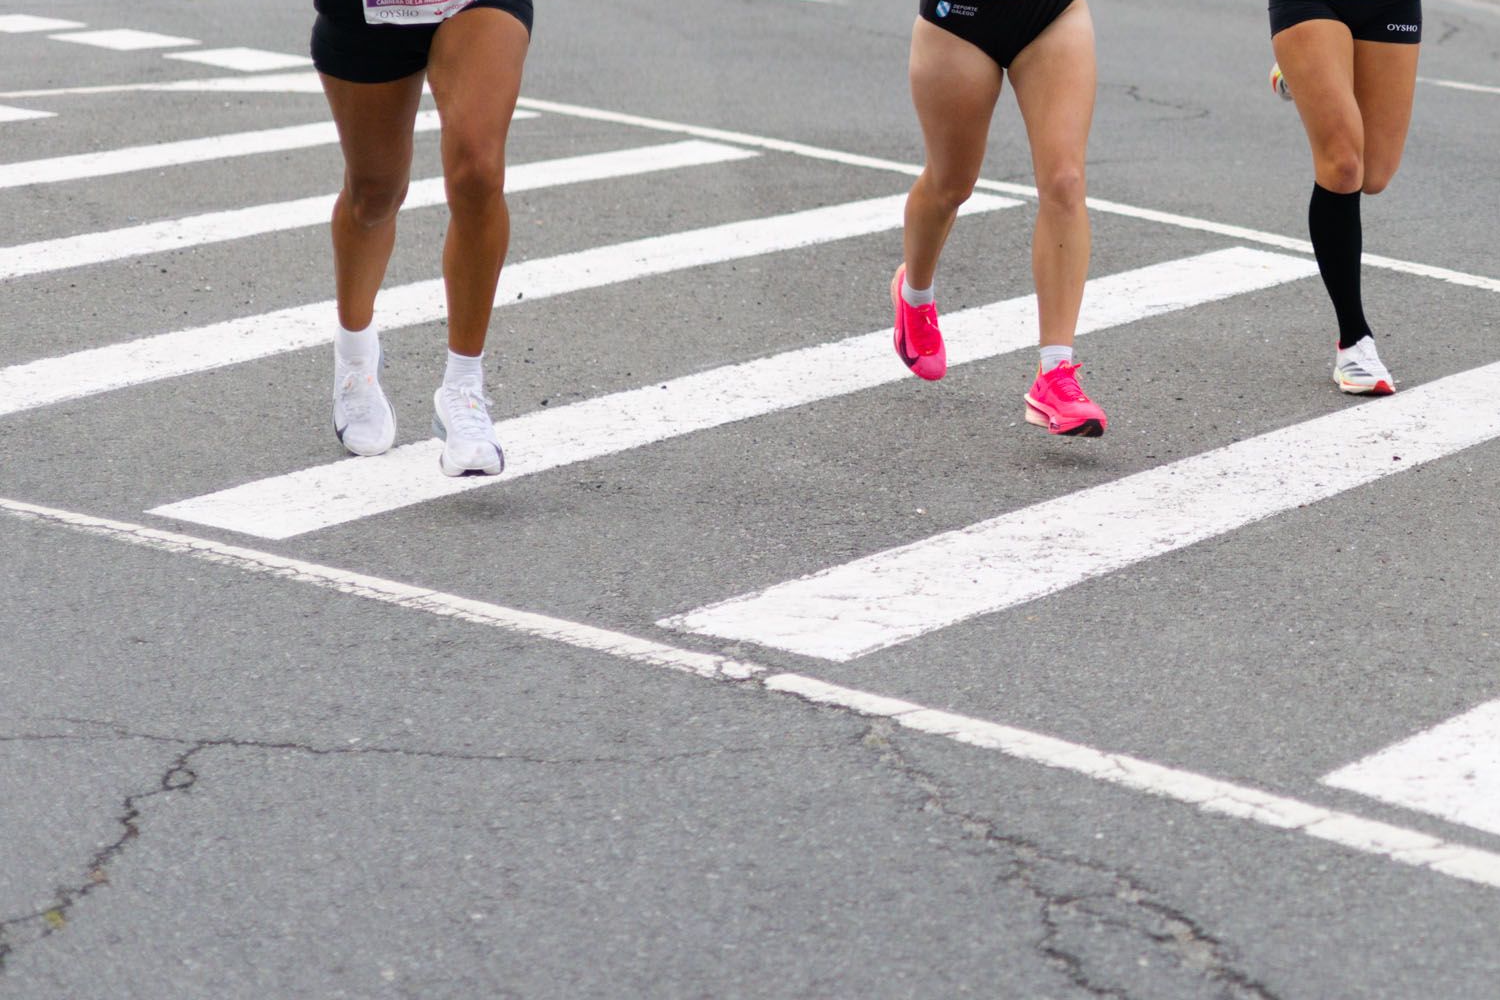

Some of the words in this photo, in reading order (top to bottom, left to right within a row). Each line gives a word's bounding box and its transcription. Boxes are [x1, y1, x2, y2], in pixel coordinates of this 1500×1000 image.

[952, 3, 978, 12] DEPORTE
[380, 9, 419, 18] OYSHO
[1386, 23, 1418, 32] OYSHO
